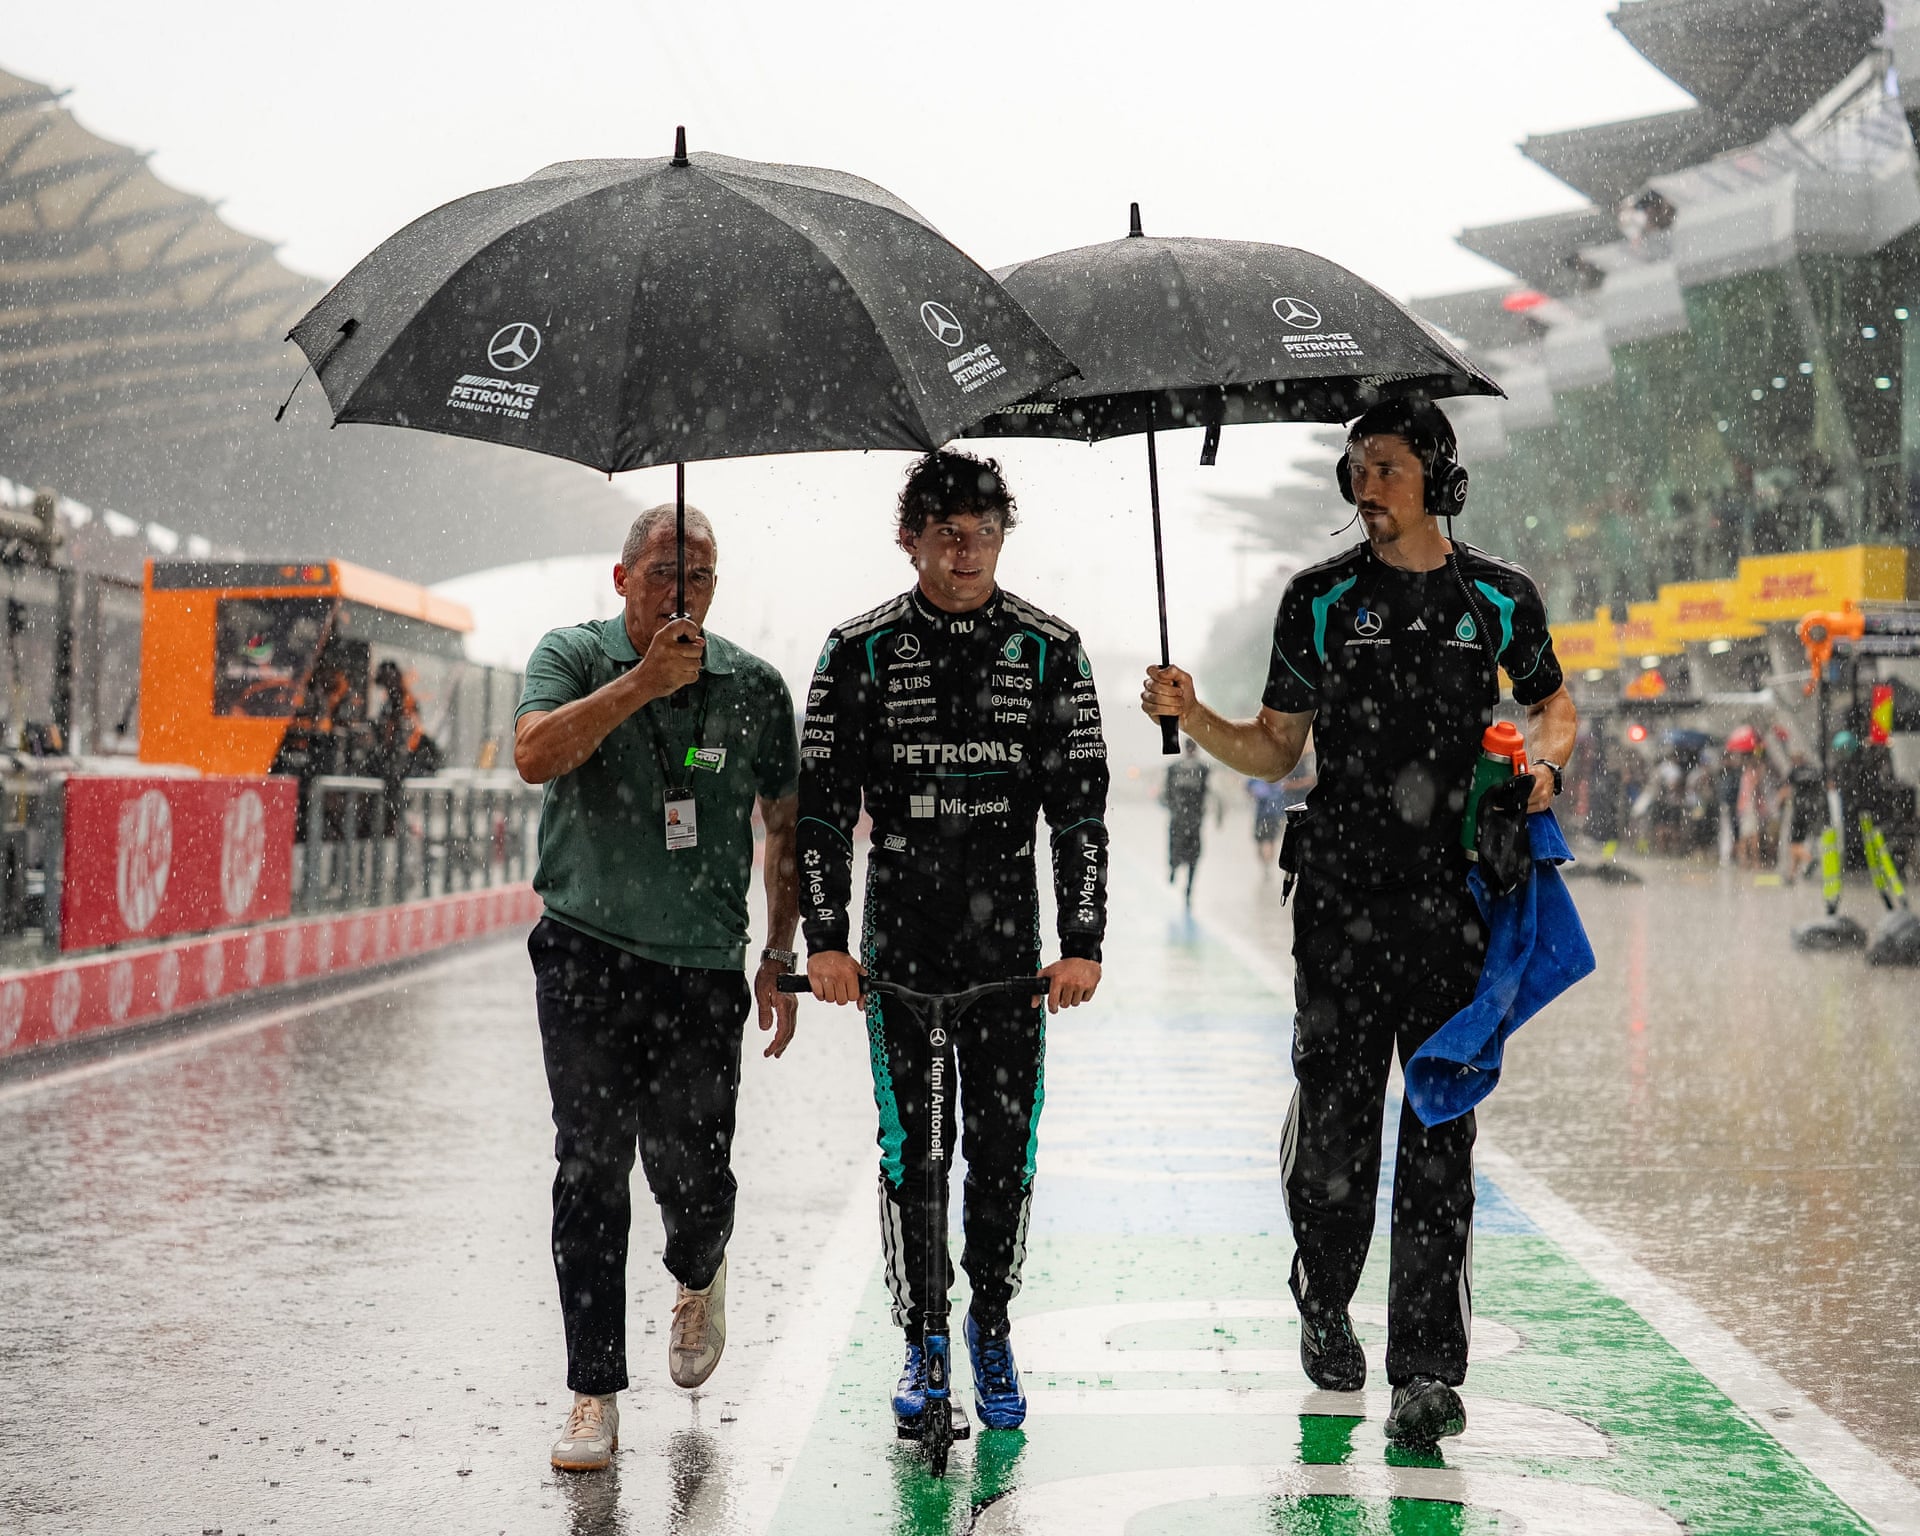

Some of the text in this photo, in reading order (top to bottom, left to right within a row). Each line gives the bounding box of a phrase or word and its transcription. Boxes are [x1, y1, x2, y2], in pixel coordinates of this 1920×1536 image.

[1284, 341, 1359, 352] PETRONAS
[952, 354, 1001, 386] PETRONAS
[450, 385, 535, 410] PETRONAS
[446, 399, 492, 413] FORMULA
[502, 408, 530, 420] TEAM
[1446, 640, 1483, 650] PETRONAS
[903, 675, 931, 690] UBS
[991, 674, 1033, 690] INEOS
[994, 711, 1028, 724] HPE
[884, 836, 907, 849] OMP
[1079, 843, 1099, 906] Meta AI
[806, 869, 836, 921] Meta AI
[931, 1057, 945, 1161] Kimi Antonelli
